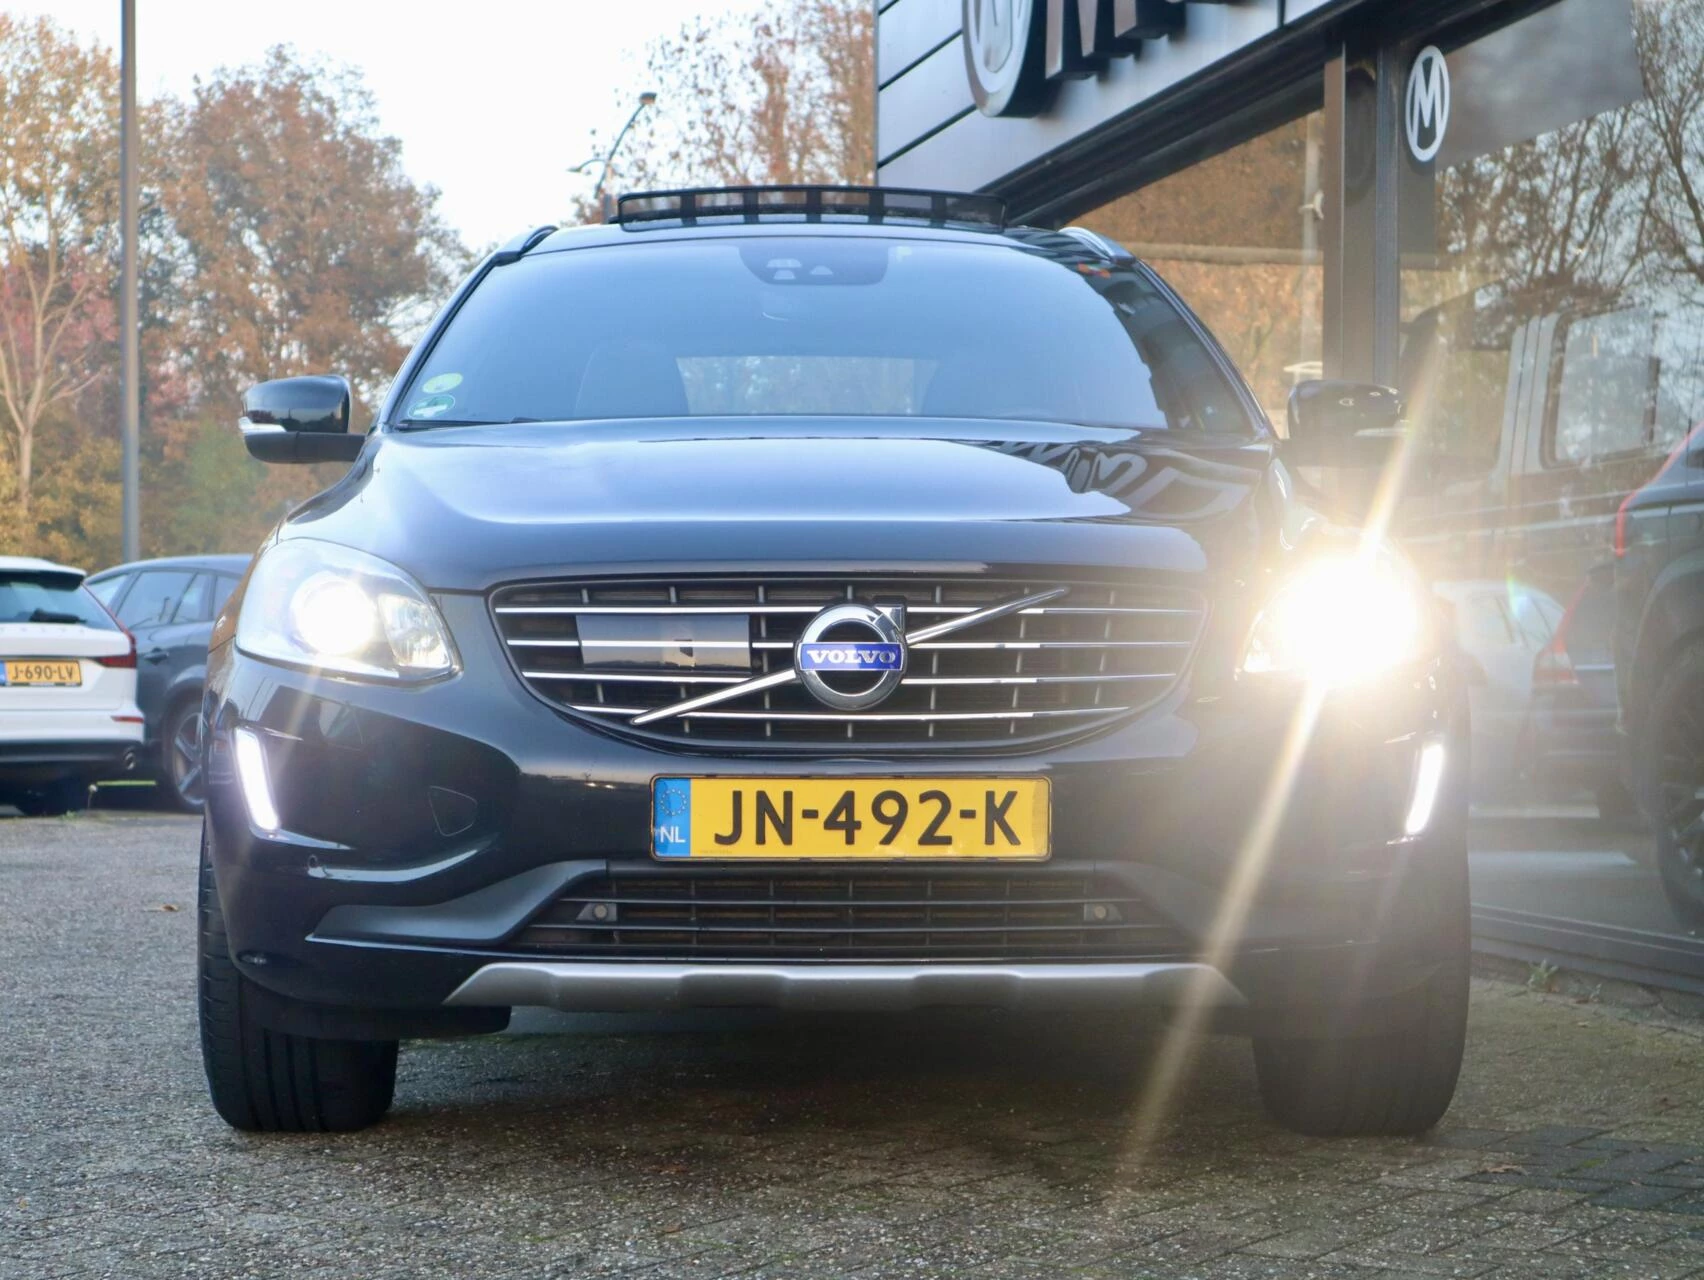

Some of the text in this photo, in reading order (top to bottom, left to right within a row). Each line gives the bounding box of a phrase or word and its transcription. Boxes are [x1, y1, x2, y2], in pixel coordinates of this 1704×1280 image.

[1409, 47, 1445, 156] M
[806, 649, 897, 664] VOLVO
[12, 664, 74, 681] J-690-LV
[714, 789, 1022, 846] JN-492-K
[660, 825, 686, 843] NL
